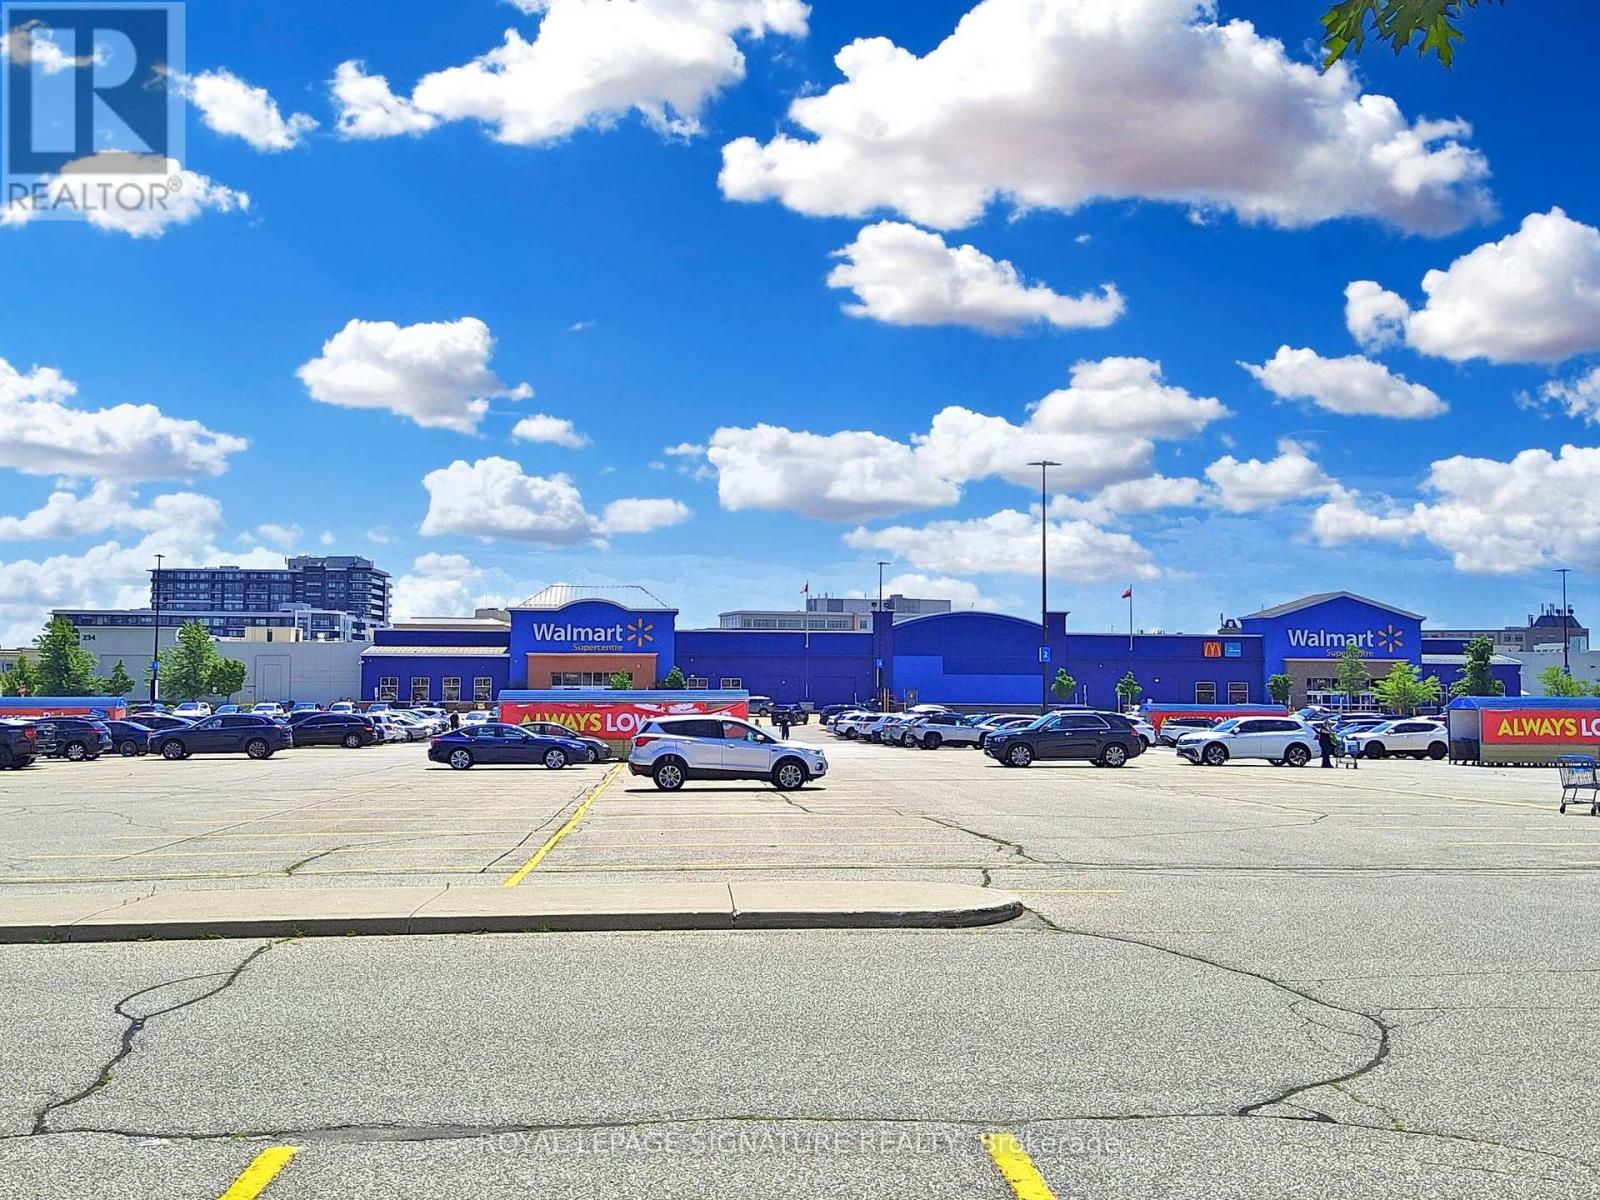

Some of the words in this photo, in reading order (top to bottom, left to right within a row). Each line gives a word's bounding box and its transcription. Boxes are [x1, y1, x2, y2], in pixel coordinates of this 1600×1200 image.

[532, 622, 624, 642] Walmart
[1287, 629, 1375, 648] Walmart
[572, 643, 624, 652] Supercentre
[1497, 717, 1577, 737] ALWAYS
